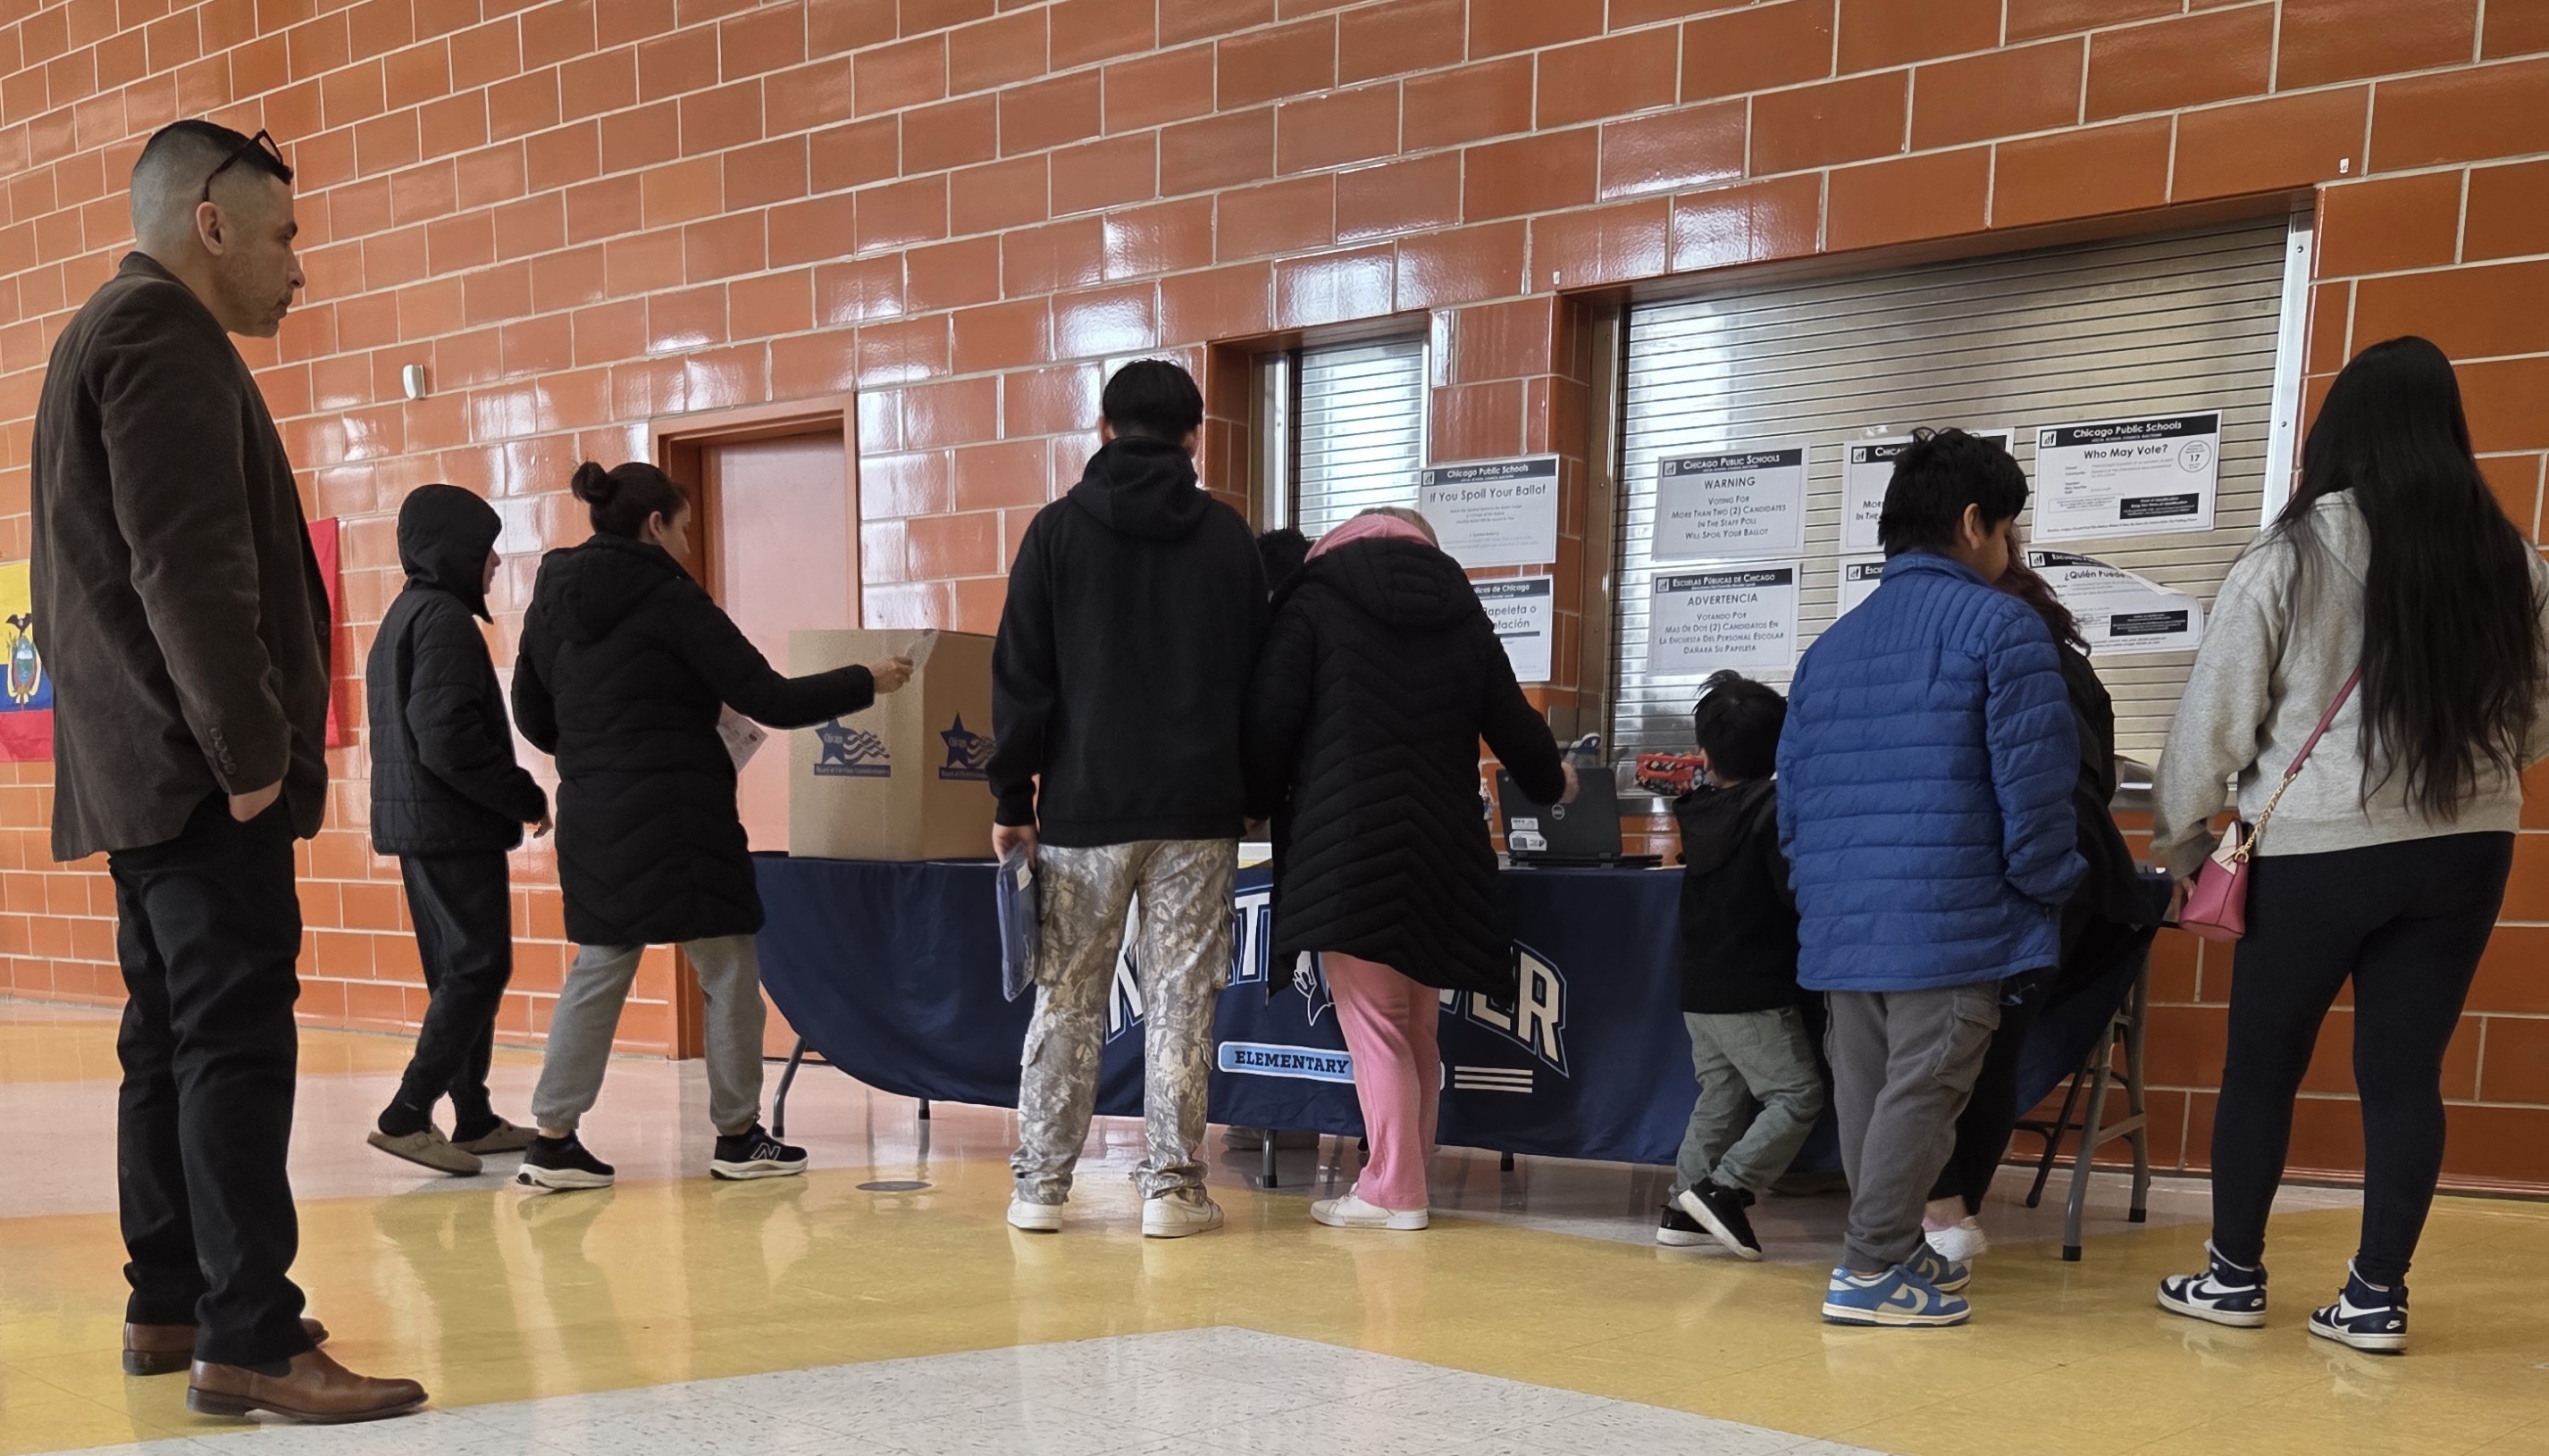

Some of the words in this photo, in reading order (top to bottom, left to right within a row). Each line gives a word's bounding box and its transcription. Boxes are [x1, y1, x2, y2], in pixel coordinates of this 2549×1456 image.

[2074, 429, 2113, 438] Chicago
[2116, 425, 2143, 434] Public
[2145, 421, 2182, 431] Schools
[2084, 450, 2107, 459] Who
[2110, 448, 2134, 458] May
[2137, 444, 2168, 455] Vote?
[2191, 454, 2200, 462] 17
[1446, 470, 1477, 478] Chicago
[1479, 468, 1500, 476] Public
[1502, 464, 1529, 473] Schools
[1705, 477, 1756, 490] WARNING
[1430, 493, 1436, 503] If
[1438, 492, 1458, 502] You
[1461, 489, 1487, 502] Spoil
[1489, 488, 1513, 498] Your
[1515, 484, 1546, 496] Ballot
[1730, 506, 1740, 516] (2)
[1473, 585, 1491, 594] licas
[1492, 585, 1501, 593] de
[1502, 584, 1530, 592] Chicago
[1687, 593, 1758, 607] ADVERTENCIA
[1530, 606, 1537, 614] o
[1493, 618, 1530, 630] ntación
[1709, 623, 1721, 633] (2)
[1235, 1050, 1349, 1075] ELEMENTARY
